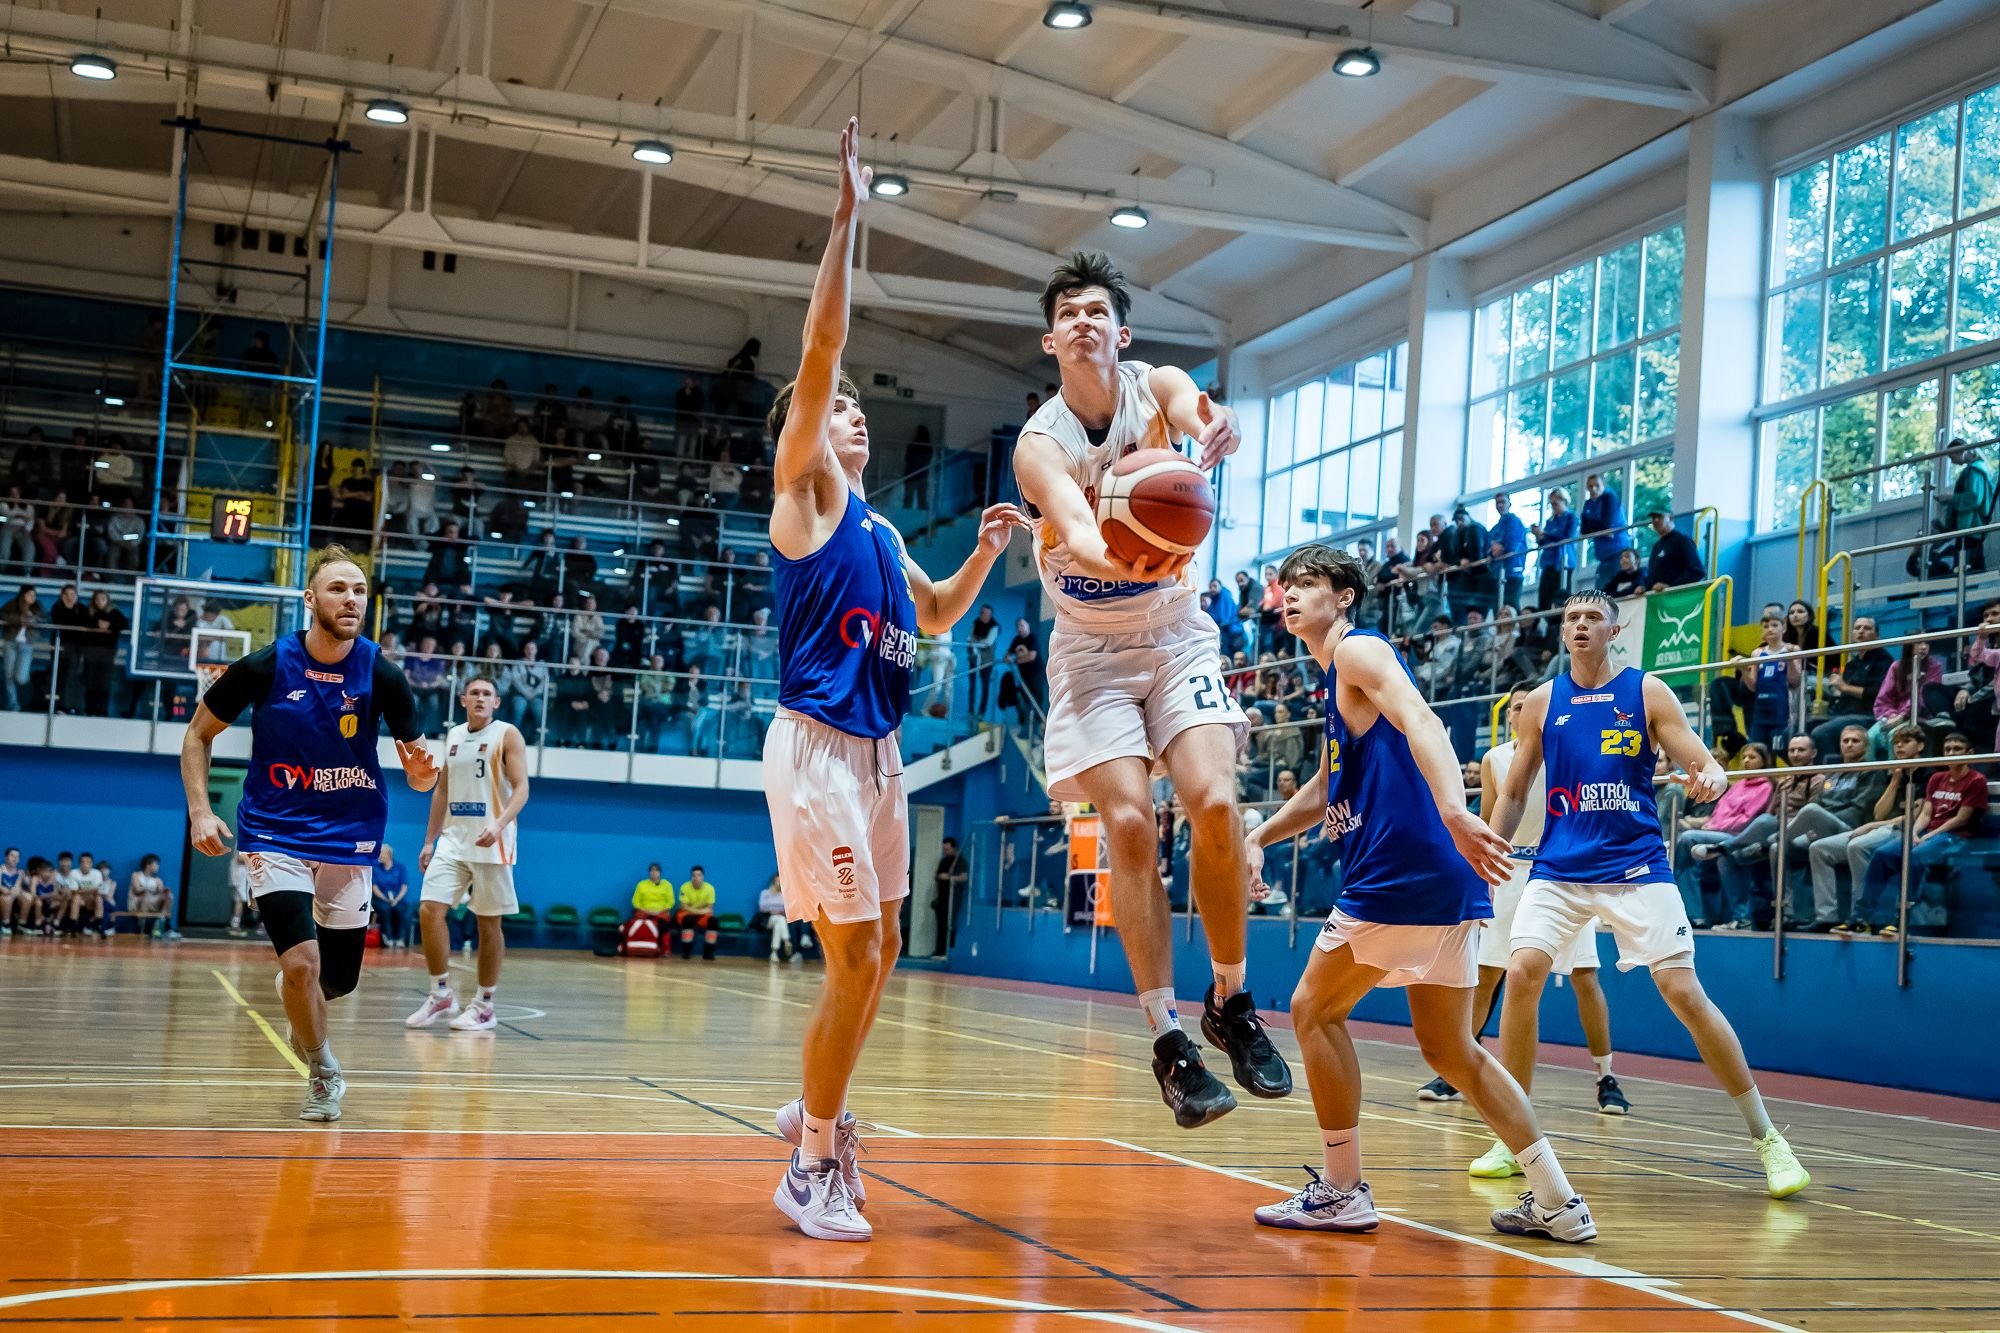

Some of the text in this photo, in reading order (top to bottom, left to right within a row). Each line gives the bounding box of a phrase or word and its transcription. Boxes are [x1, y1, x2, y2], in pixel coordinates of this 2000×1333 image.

[224, 515, 247, 536] 17
[1601, 729, 1642, 757] 23
[475, 759, 485, 778] 3
